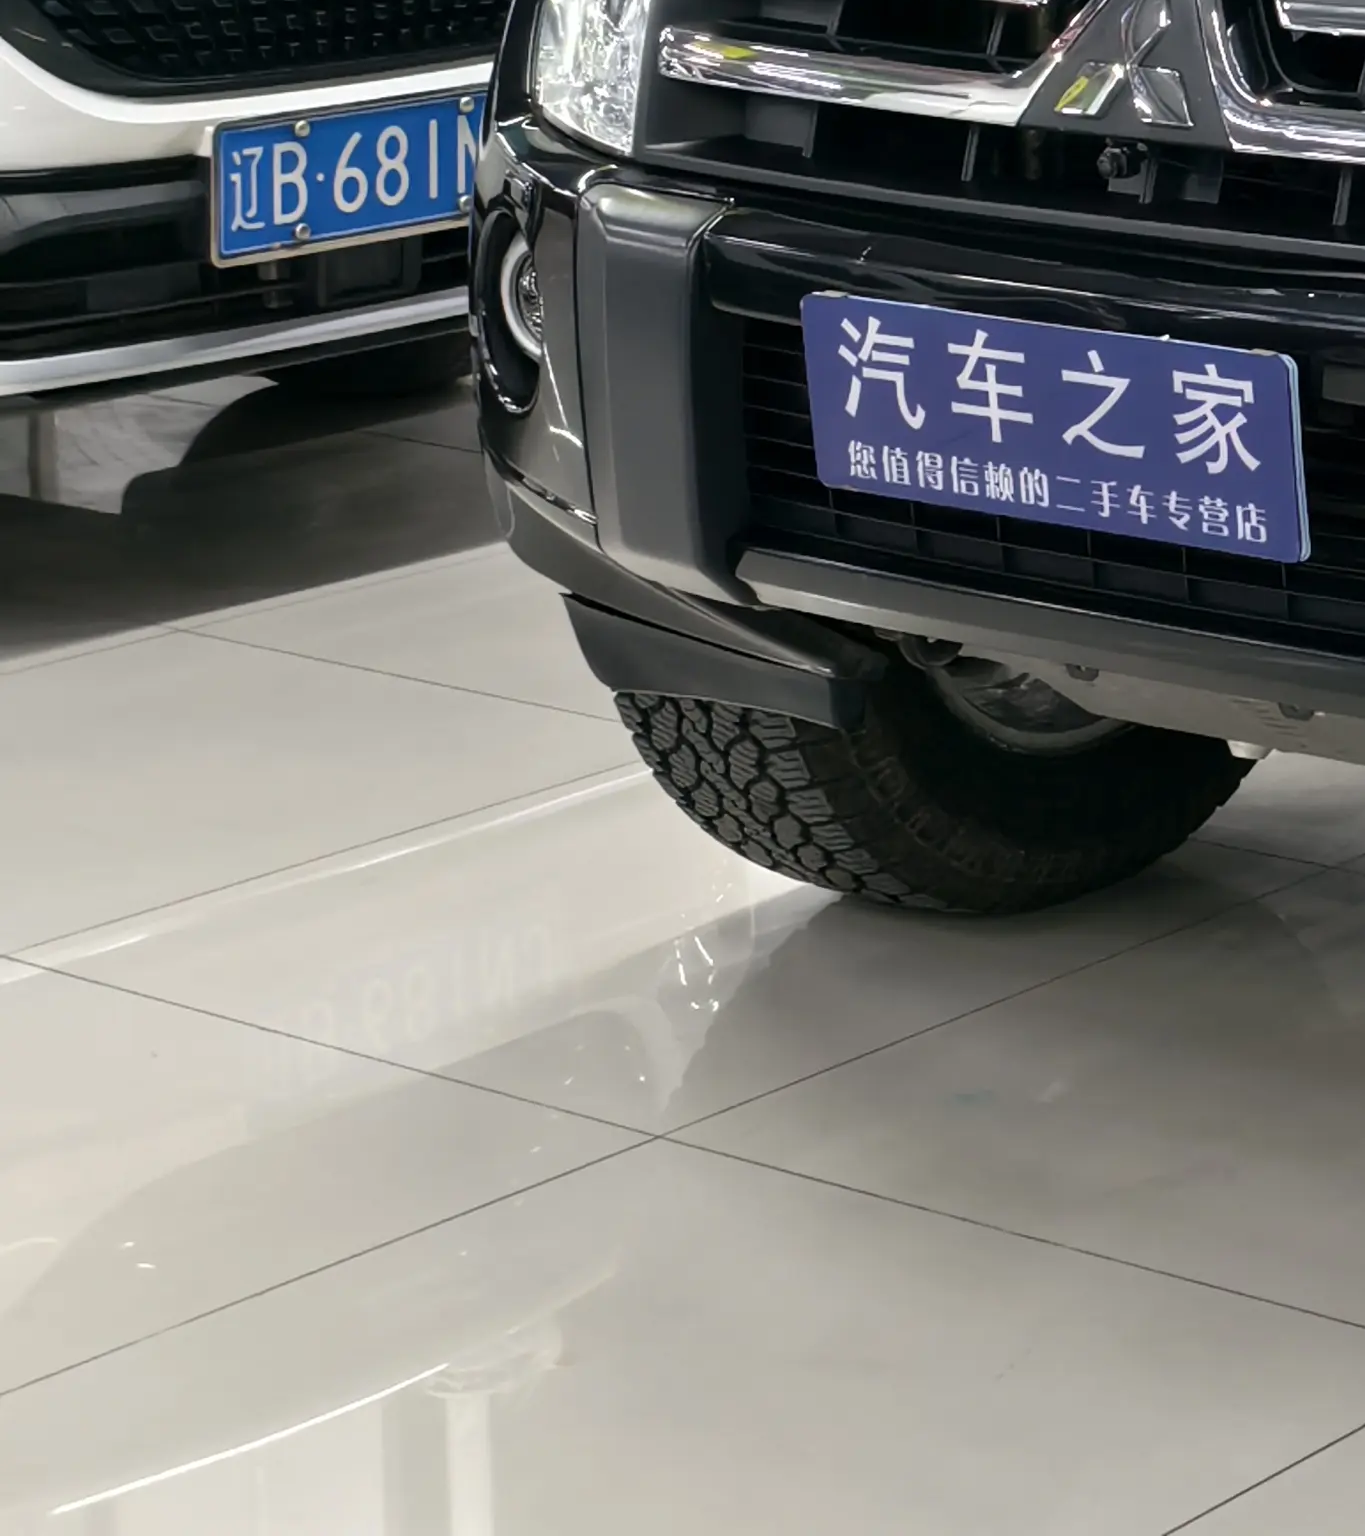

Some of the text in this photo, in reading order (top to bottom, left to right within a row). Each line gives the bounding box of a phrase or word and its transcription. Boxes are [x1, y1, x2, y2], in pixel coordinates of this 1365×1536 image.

[838, 316, 1262, 475] 汽车之家
[848, 440, 1268, 543] 您值得信赖的二手车专营店
